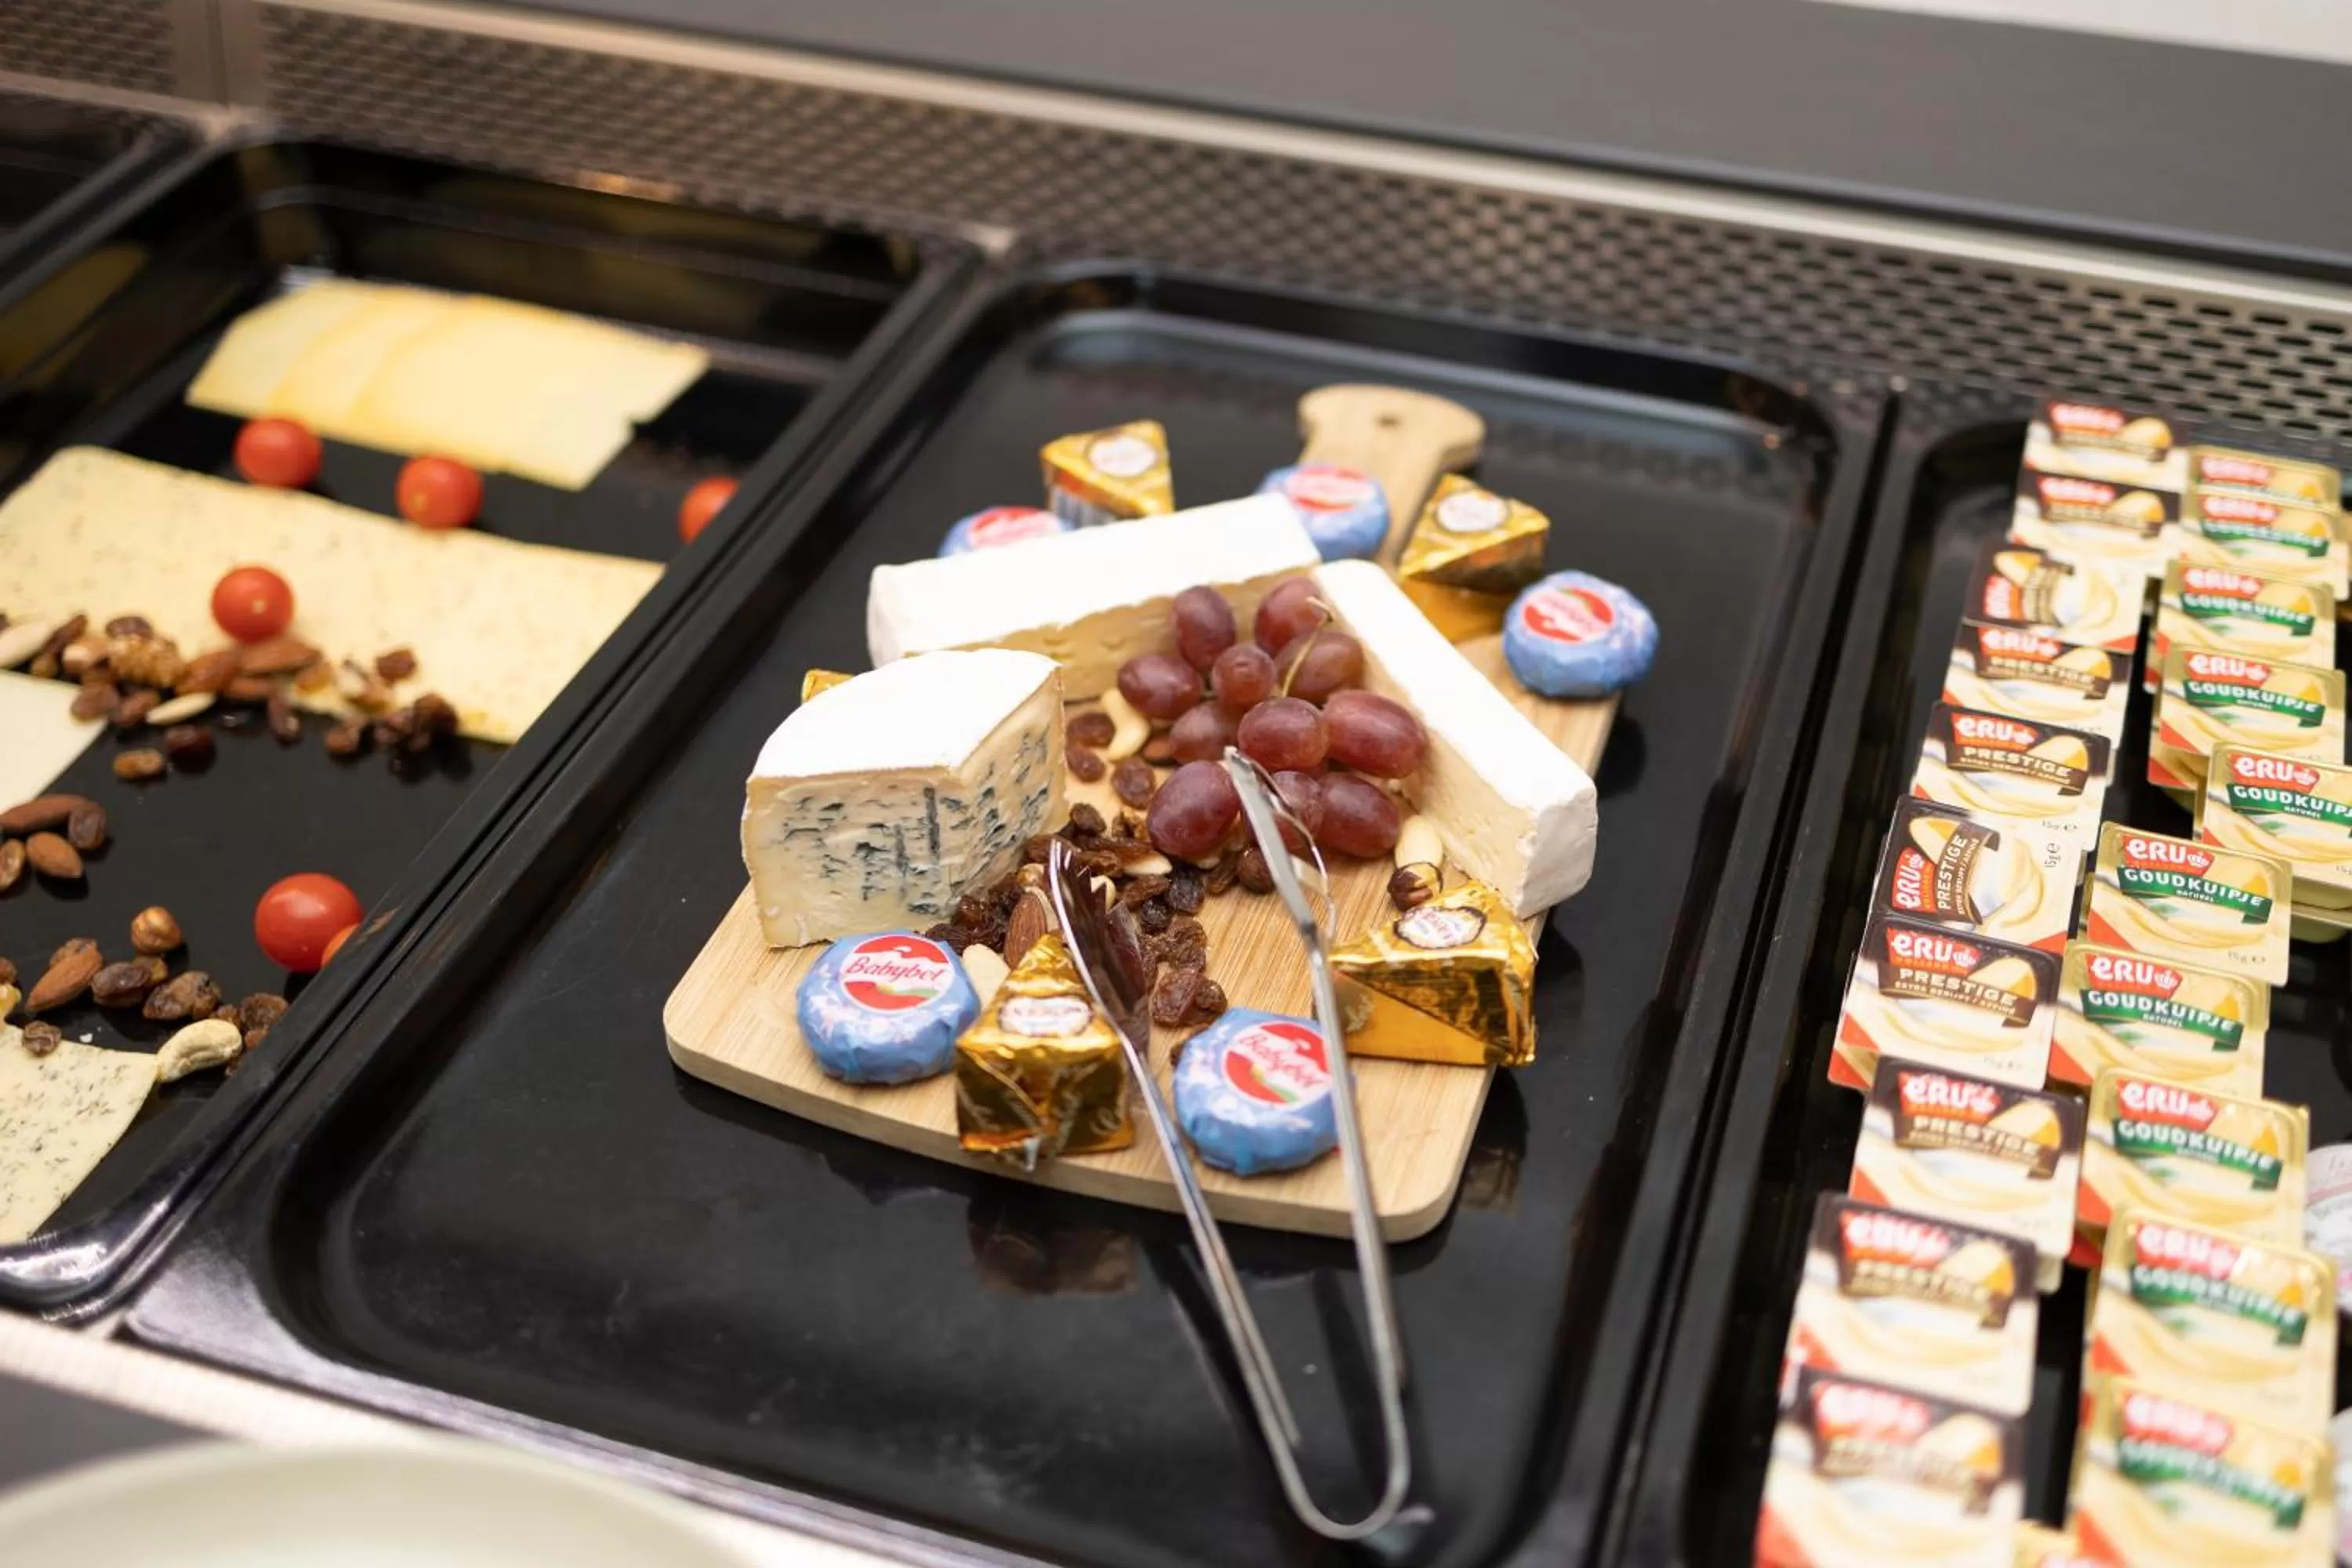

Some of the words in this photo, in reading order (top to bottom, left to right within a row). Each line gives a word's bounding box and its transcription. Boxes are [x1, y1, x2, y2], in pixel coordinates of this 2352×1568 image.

[2188, 681, 2319, 713] GOUDKUIPJE
[1962, 746, 2072, 778] PRESTIGE
[1936, 833, 1969, 910] PRESTIGE
[2124, 868, 2266, 907] GOUDKUIPJE
[1899, 967, 2018, 1007] PRESTIGE
[2088, 989, 2237, 1032] GOUDKUIPJE
[2118, 1120, 2275, 1171] GOUDKUIPJE
